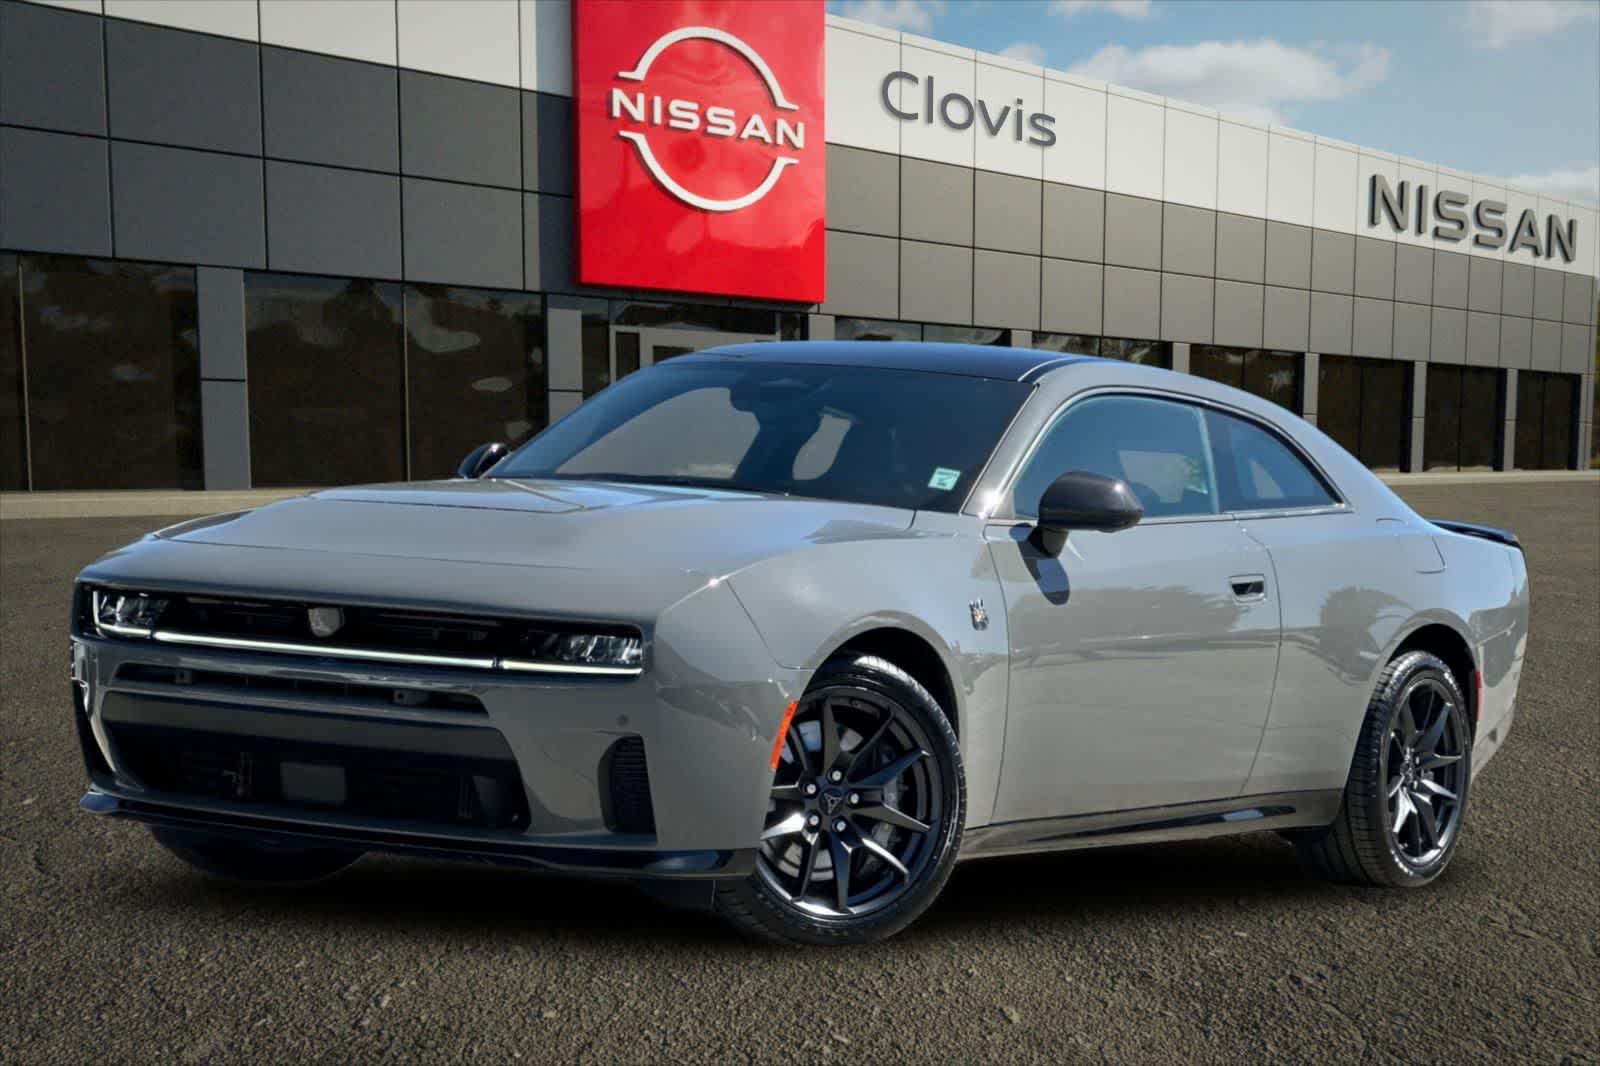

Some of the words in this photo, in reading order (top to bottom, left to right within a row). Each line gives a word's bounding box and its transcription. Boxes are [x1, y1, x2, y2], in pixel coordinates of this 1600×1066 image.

[611, 87, 805, 149] NISSAN
[881, 70, 1057, 147] Clovis
[1368, 173, 1578, 263] NISSAN
